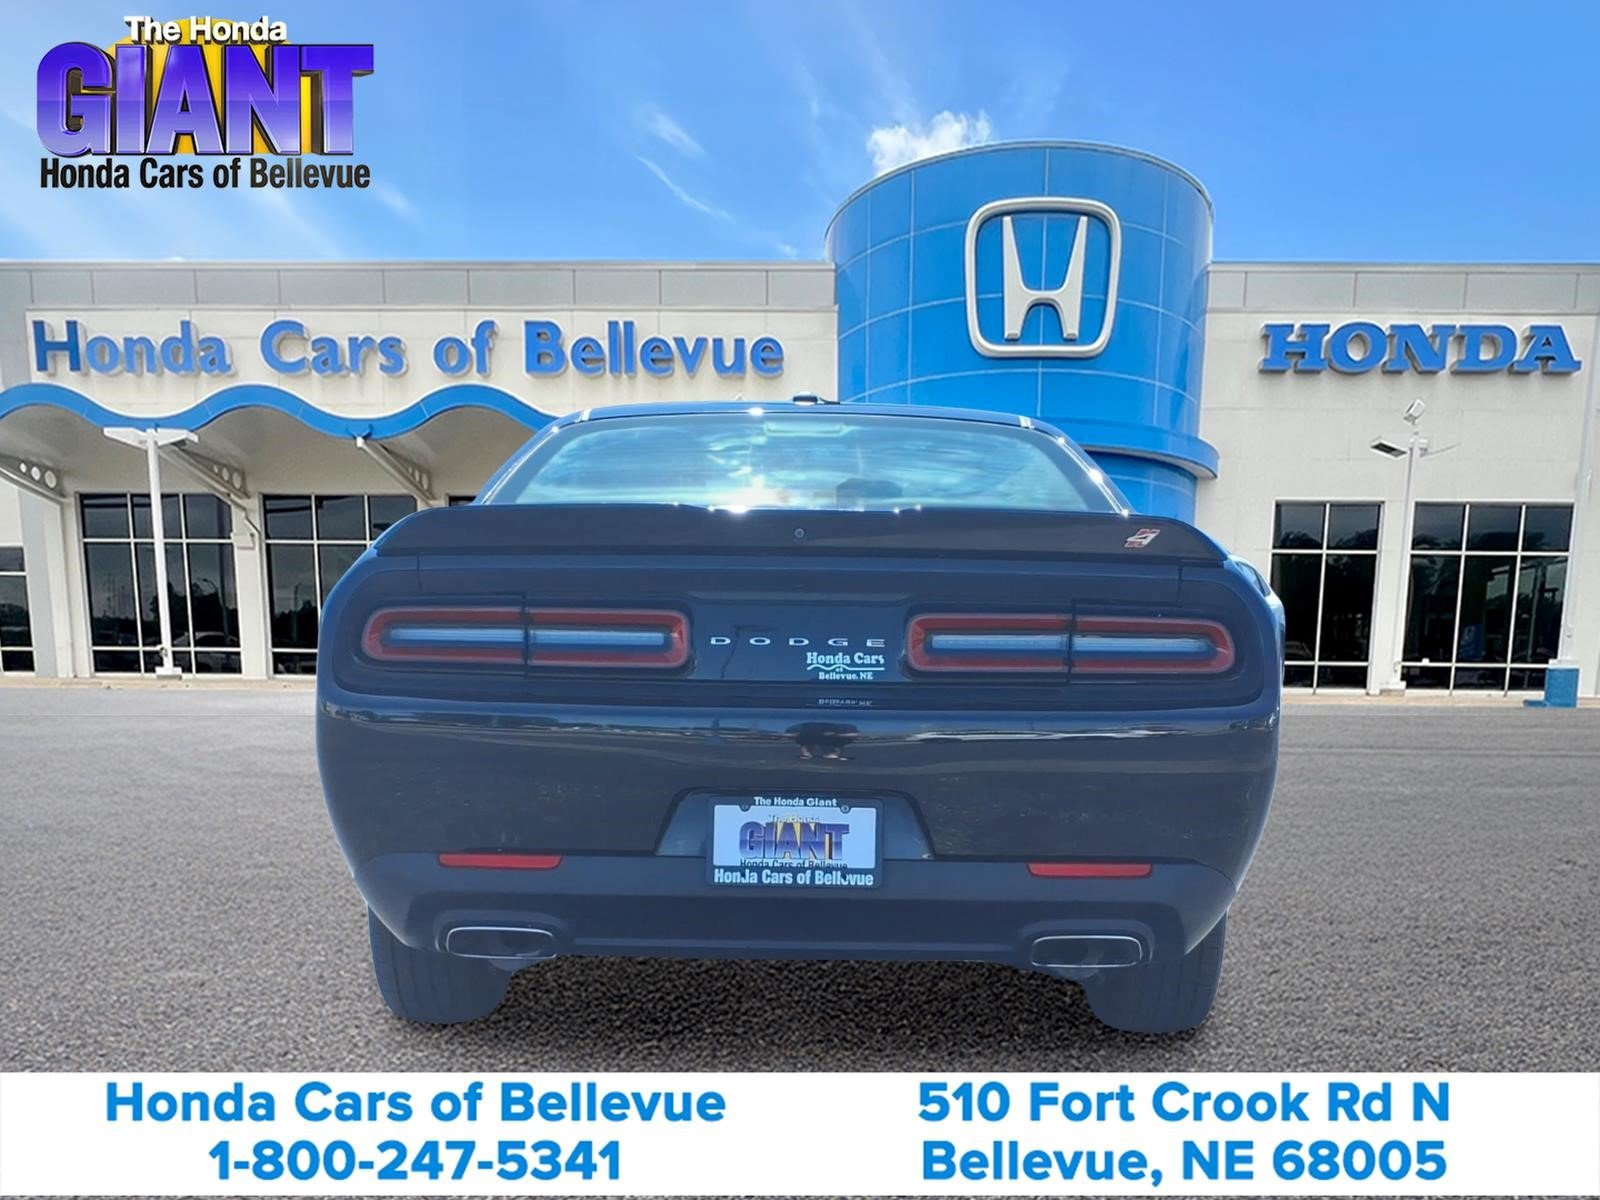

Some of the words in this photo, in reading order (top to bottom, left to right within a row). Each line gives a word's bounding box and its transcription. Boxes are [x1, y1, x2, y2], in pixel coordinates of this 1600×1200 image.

[32, 319, 234, 376] Honda
[260, 319, 408, 376] Cars
[433, 319, 498, 377] of
[524, 320, 785, 378] Bellevue
[1259, 322, 1583, 375] HONDA
[710, 636, 886, 648] DODGE
[806, 652, 851, 664] Honda
[853, 652, 885, 664] Cars
[859, 671, 874, 680] NE
[753, 796, 772, 806] The
[773, 796, 804, 806] Honda
[806, 798, 838, 807] Giant
[739, 821, 850, 860] GIANT
[761, 869, 793, 884] Cars
[796, 870, 811, 885] of
